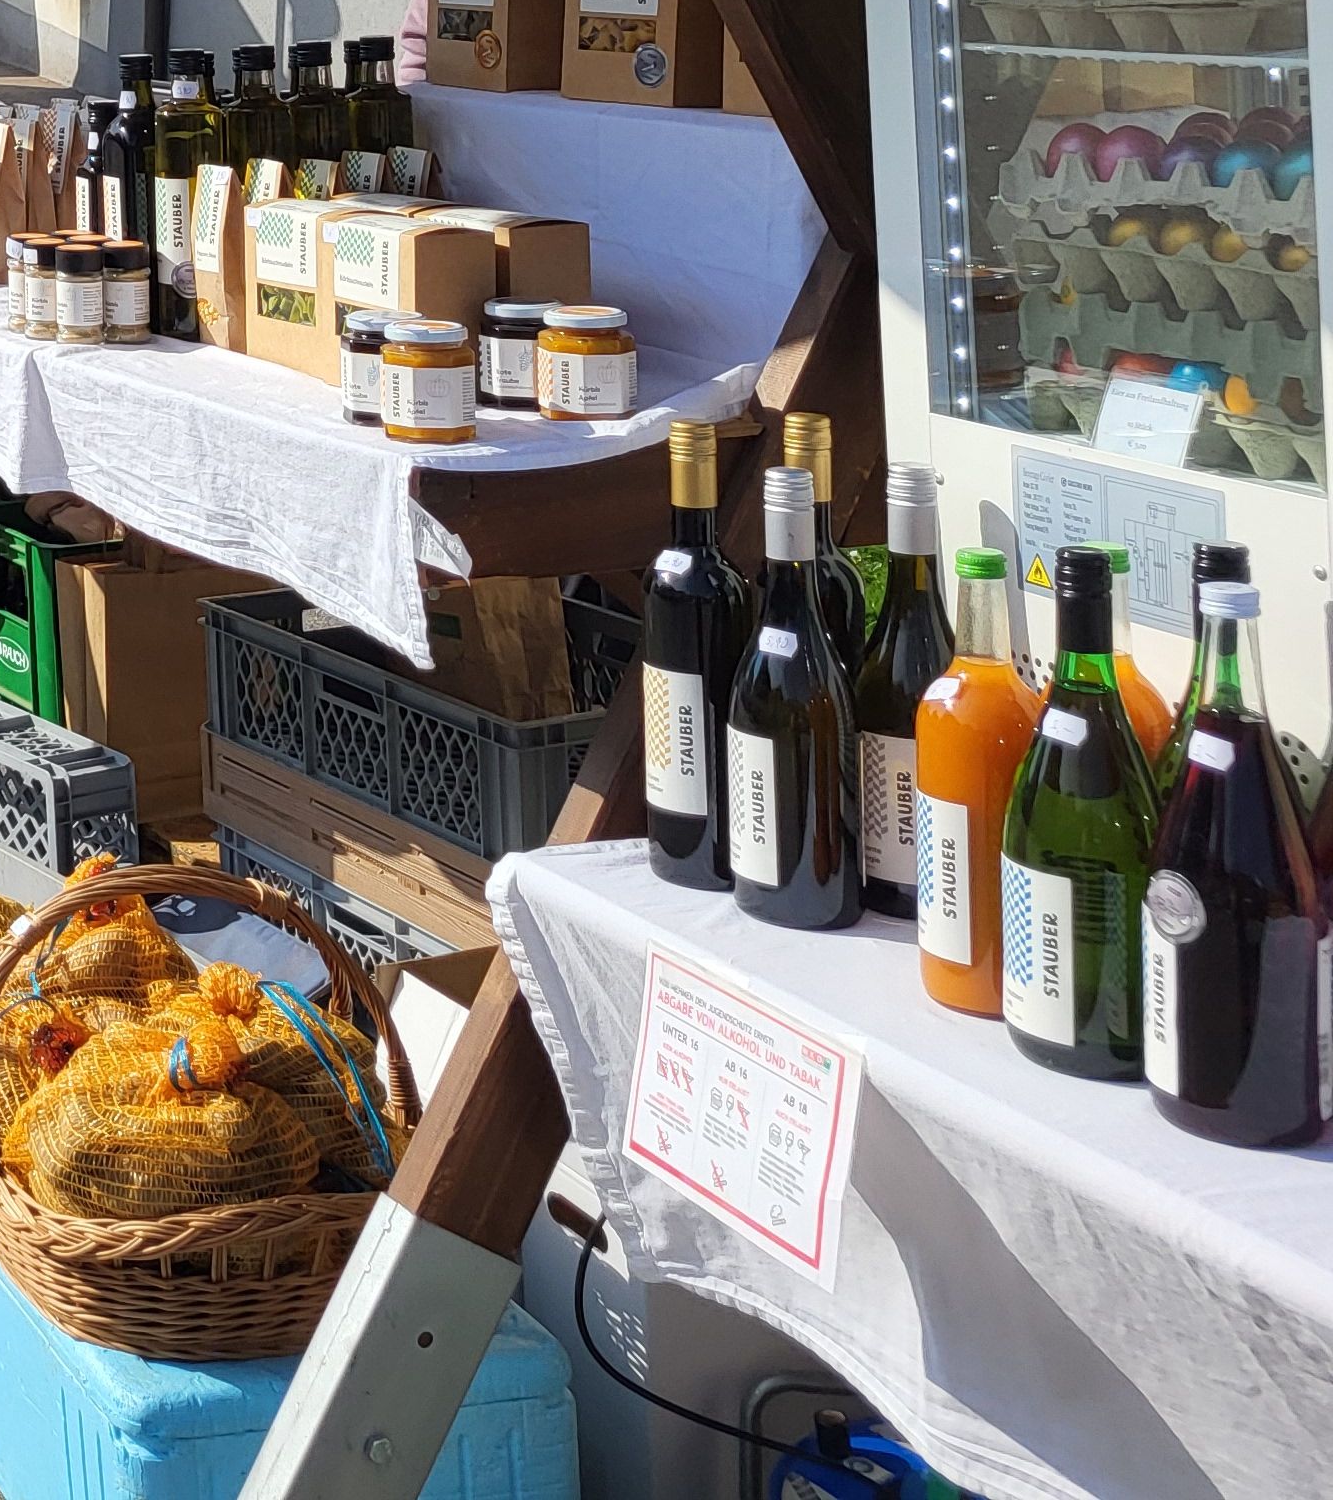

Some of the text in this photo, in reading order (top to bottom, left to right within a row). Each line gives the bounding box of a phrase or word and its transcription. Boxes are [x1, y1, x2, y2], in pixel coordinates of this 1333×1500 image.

[55, 126, 65, 173] STAUBER
[172, 194, 184, 248] STAUBER
[209, 190, 221, 246] STAUBER
[300, 221, 308, 275] STAUBER
[381, 240, 390, 296] STAUBER
[561, 360, 570, 405] STAUBER
[2, 643, 26, 669] RAUCH
[679, 705, 694, 777] STAUBER
[752, 770, 766, 845] STAUBER
[897, 771, 915, 846] STAUBER
[940, 837, 957, 920] STAUBER
[1042, 912, 1060, 999] STAUBER
[695, 995, 707, 1009] DEN
[1154, 953, 1167, 1044] STAUBER
[657, 990, 821, 1091] ABGABE VON ALKOHOL UND TABAK
[662, 1022, 699, 1051] UNTER 16
[725, 1059, 748, 1080] AB 16
[783, 1093, 808, 1115] AB 18
